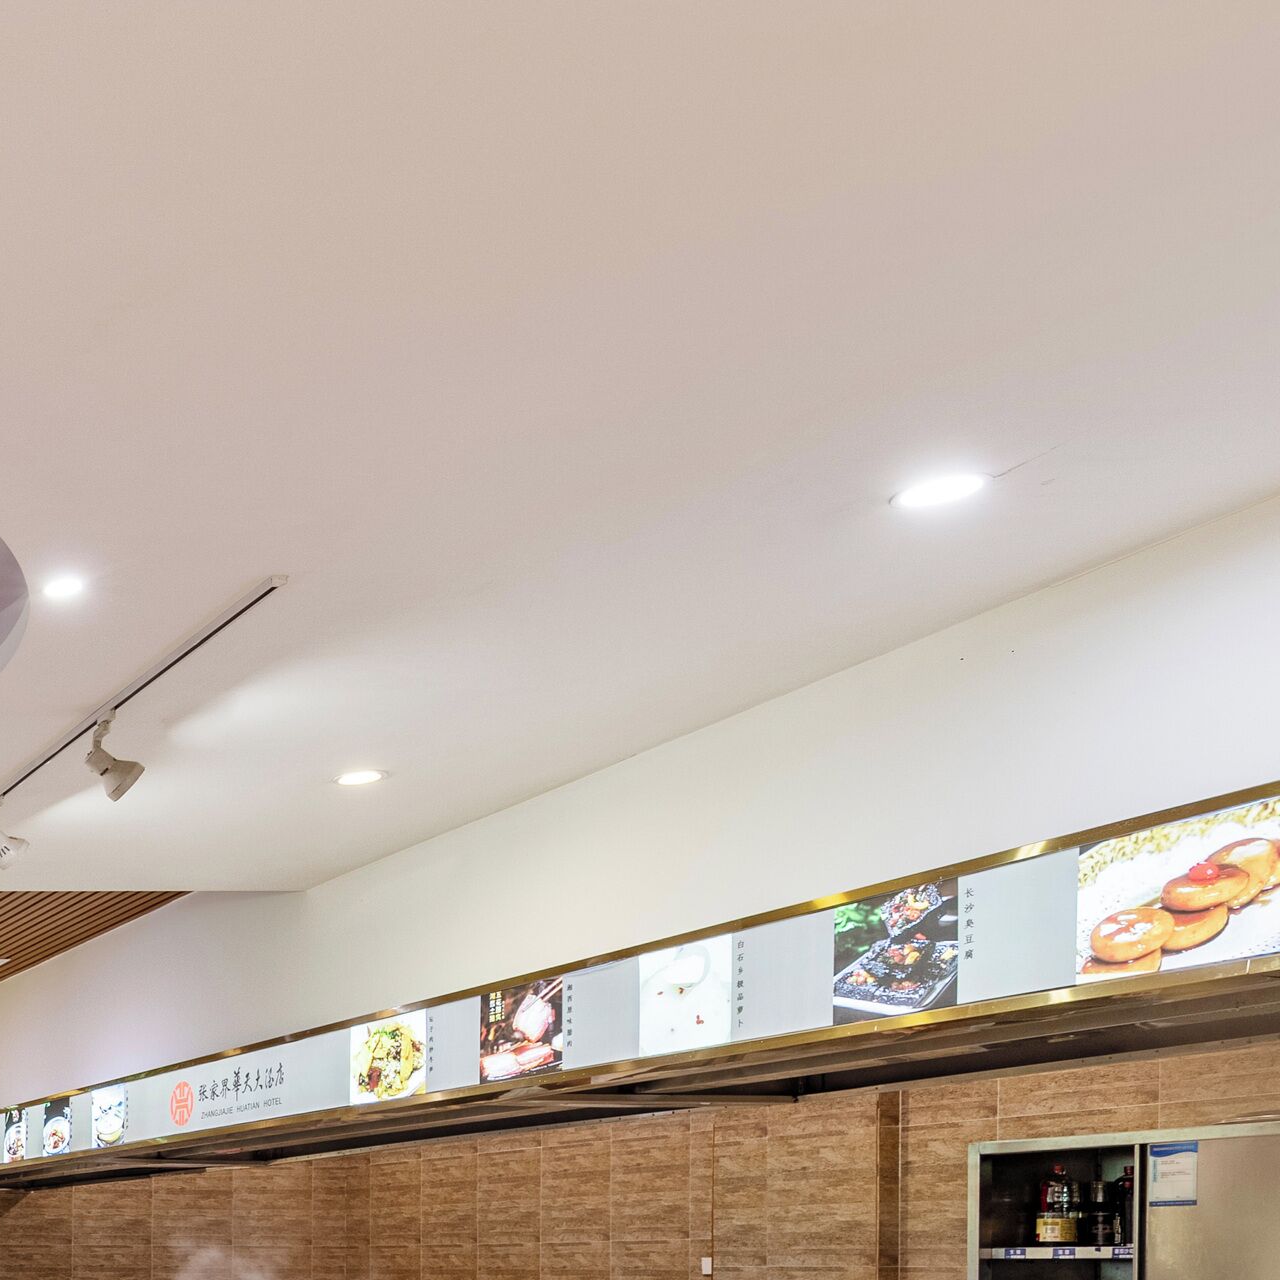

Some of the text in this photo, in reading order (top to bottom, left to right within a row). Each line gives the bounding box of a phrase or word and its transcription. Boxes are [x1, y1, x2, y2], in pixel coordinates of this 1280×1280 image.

[963, 887, 976, 961] 长沙臭豆腐
[201, 1097, 282, 1119] ZHANGJIAJIE HUATIAN HOTEL
